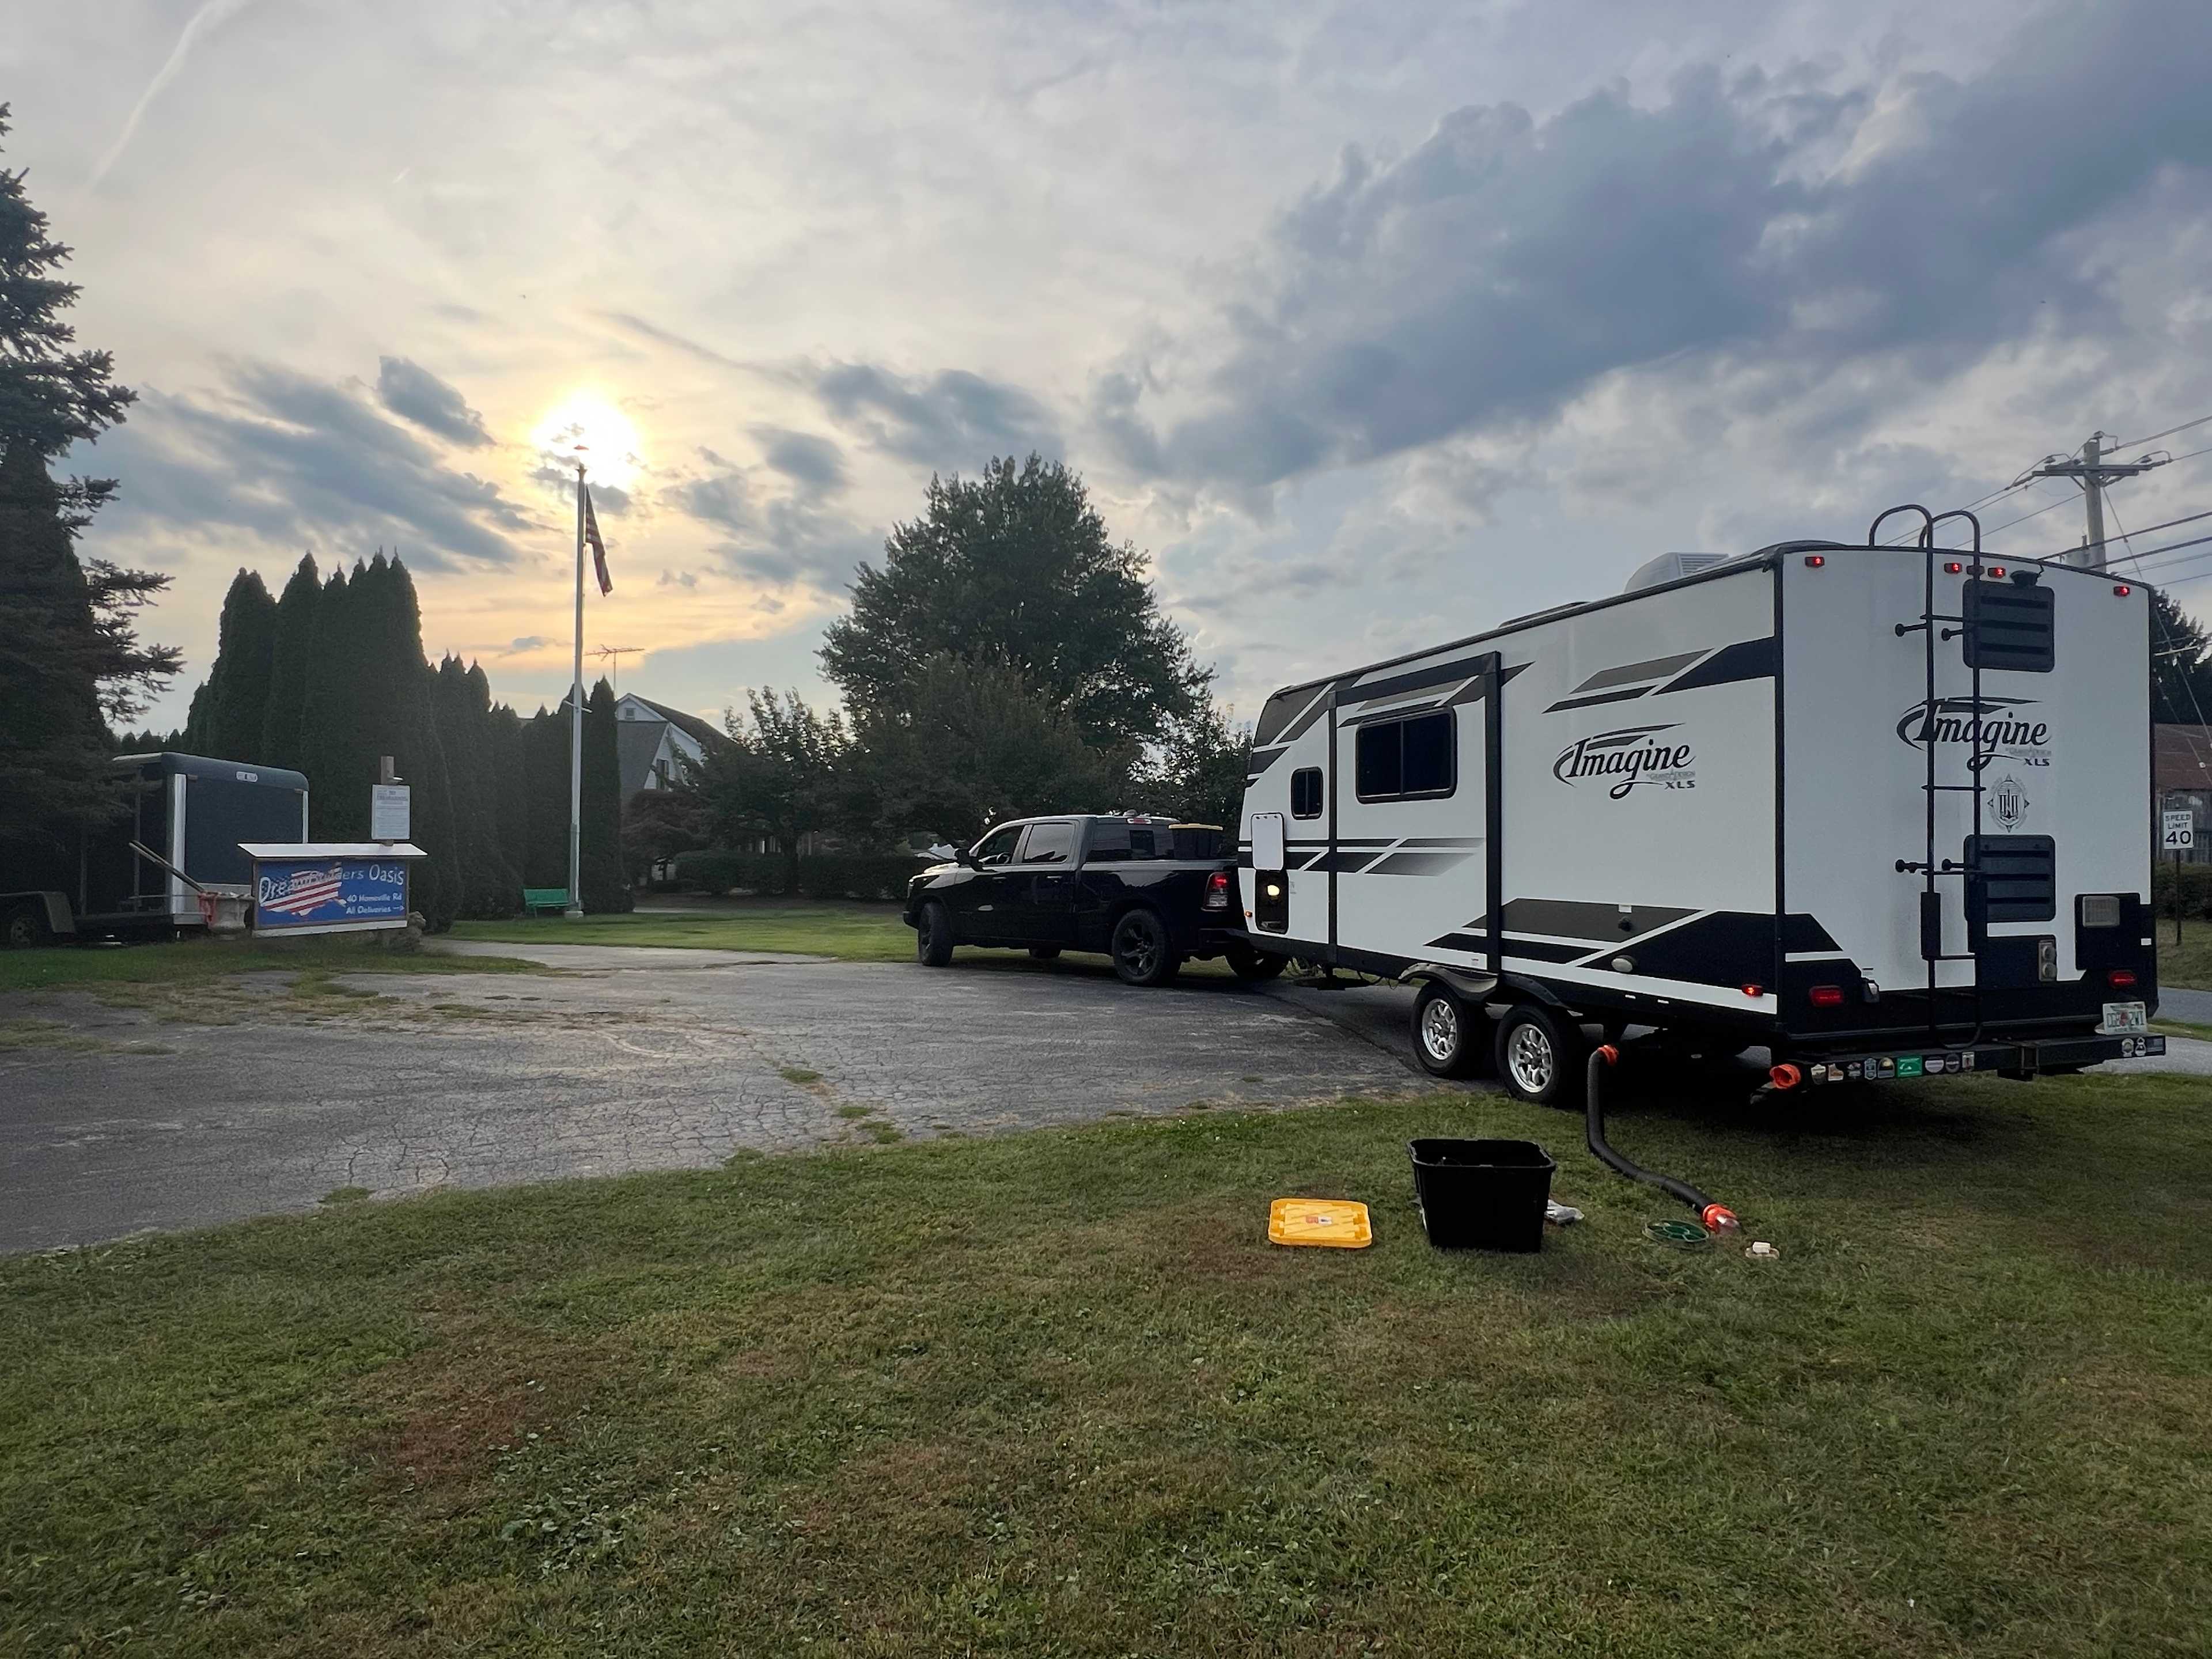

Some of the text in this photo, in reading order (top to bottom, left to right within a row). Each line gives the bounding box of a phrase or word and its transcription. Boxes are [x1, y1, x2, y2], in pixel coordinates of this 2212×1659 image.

[1911, 701, 2052, 771] Imagine
[1563, 737, 1697, 800] Imagine
[2024, 757, 2050, 766] XLS
[1664, 781, 1696, 790] XLS
[2165, 831, 2191, 845] 40
[369, 863, 405, 886] Oasis
[347, 894, 357, 903] 40
[392, 892, 402, 901] Rd
